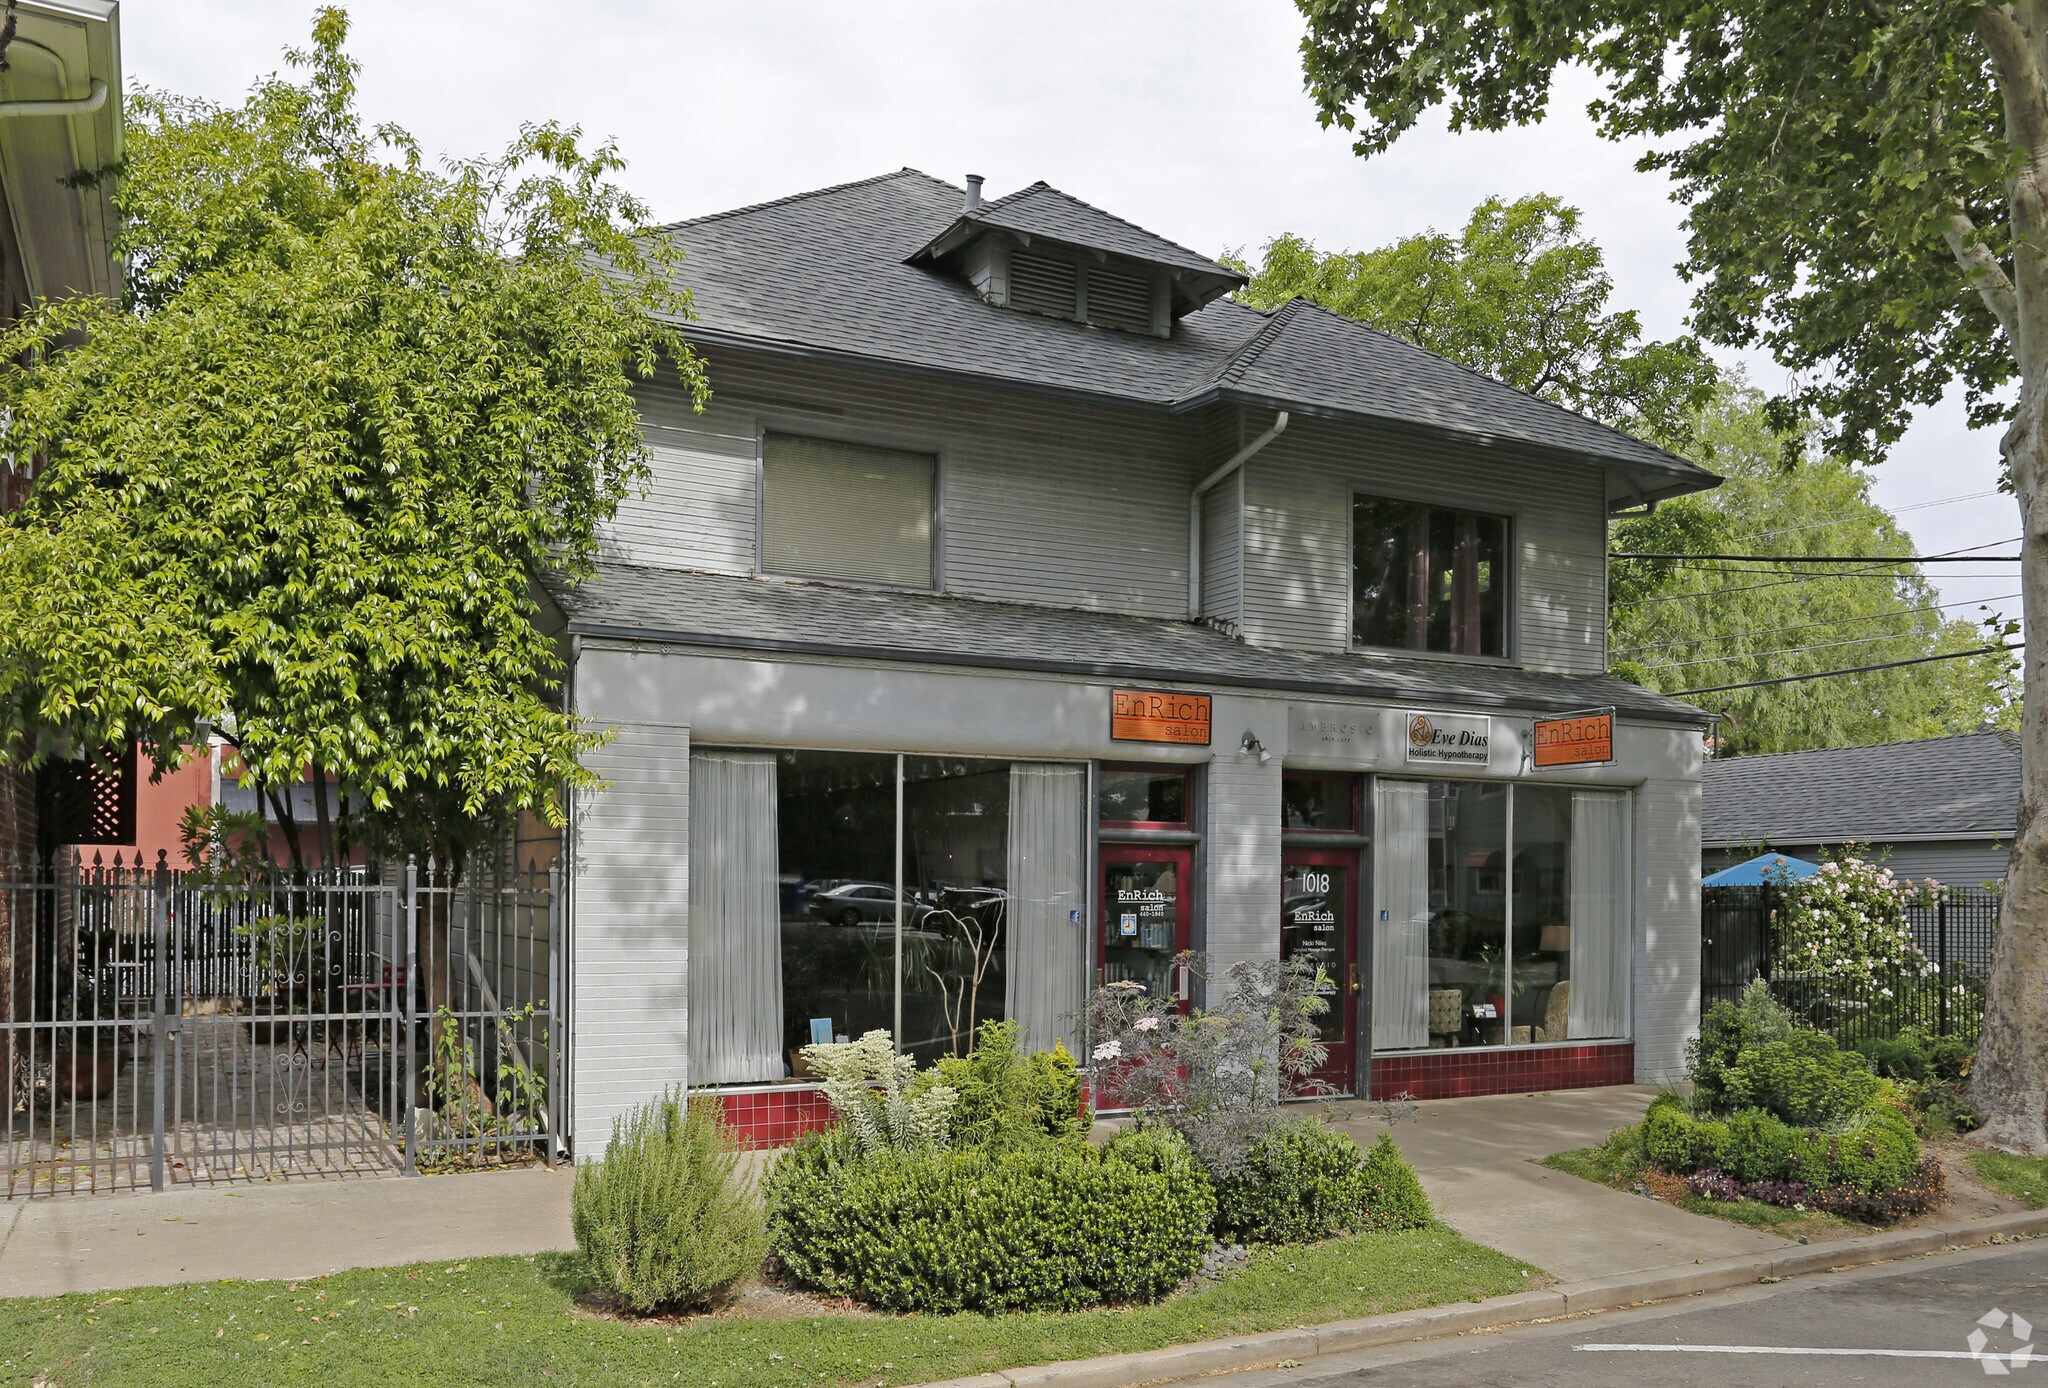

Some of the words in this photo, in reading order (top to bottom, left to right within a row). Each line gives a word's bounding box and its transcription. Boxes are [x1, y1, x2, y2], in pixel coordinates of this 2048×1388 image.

[1114, 693, 1209, 721] EnRich
[1165, 725, 1207, 738] salon
[1431, 728, 1456, 745] Eve
[1459, 730, 1488, 747] Dias
[1536, 718, 1610, 745] EnRich
[1409, 748, 1437, 757] Holistic
[1438, 749, 1488, 761] Hypnotherapy
[1574, 744, 1609, 757] salon
[1302, 873, 1330, 893] 1018
[1117, 889, 1163, 900] EnRich
[1140, 903, 1164, 911] salon
[1294, 910, 1335, 921] EnRich
